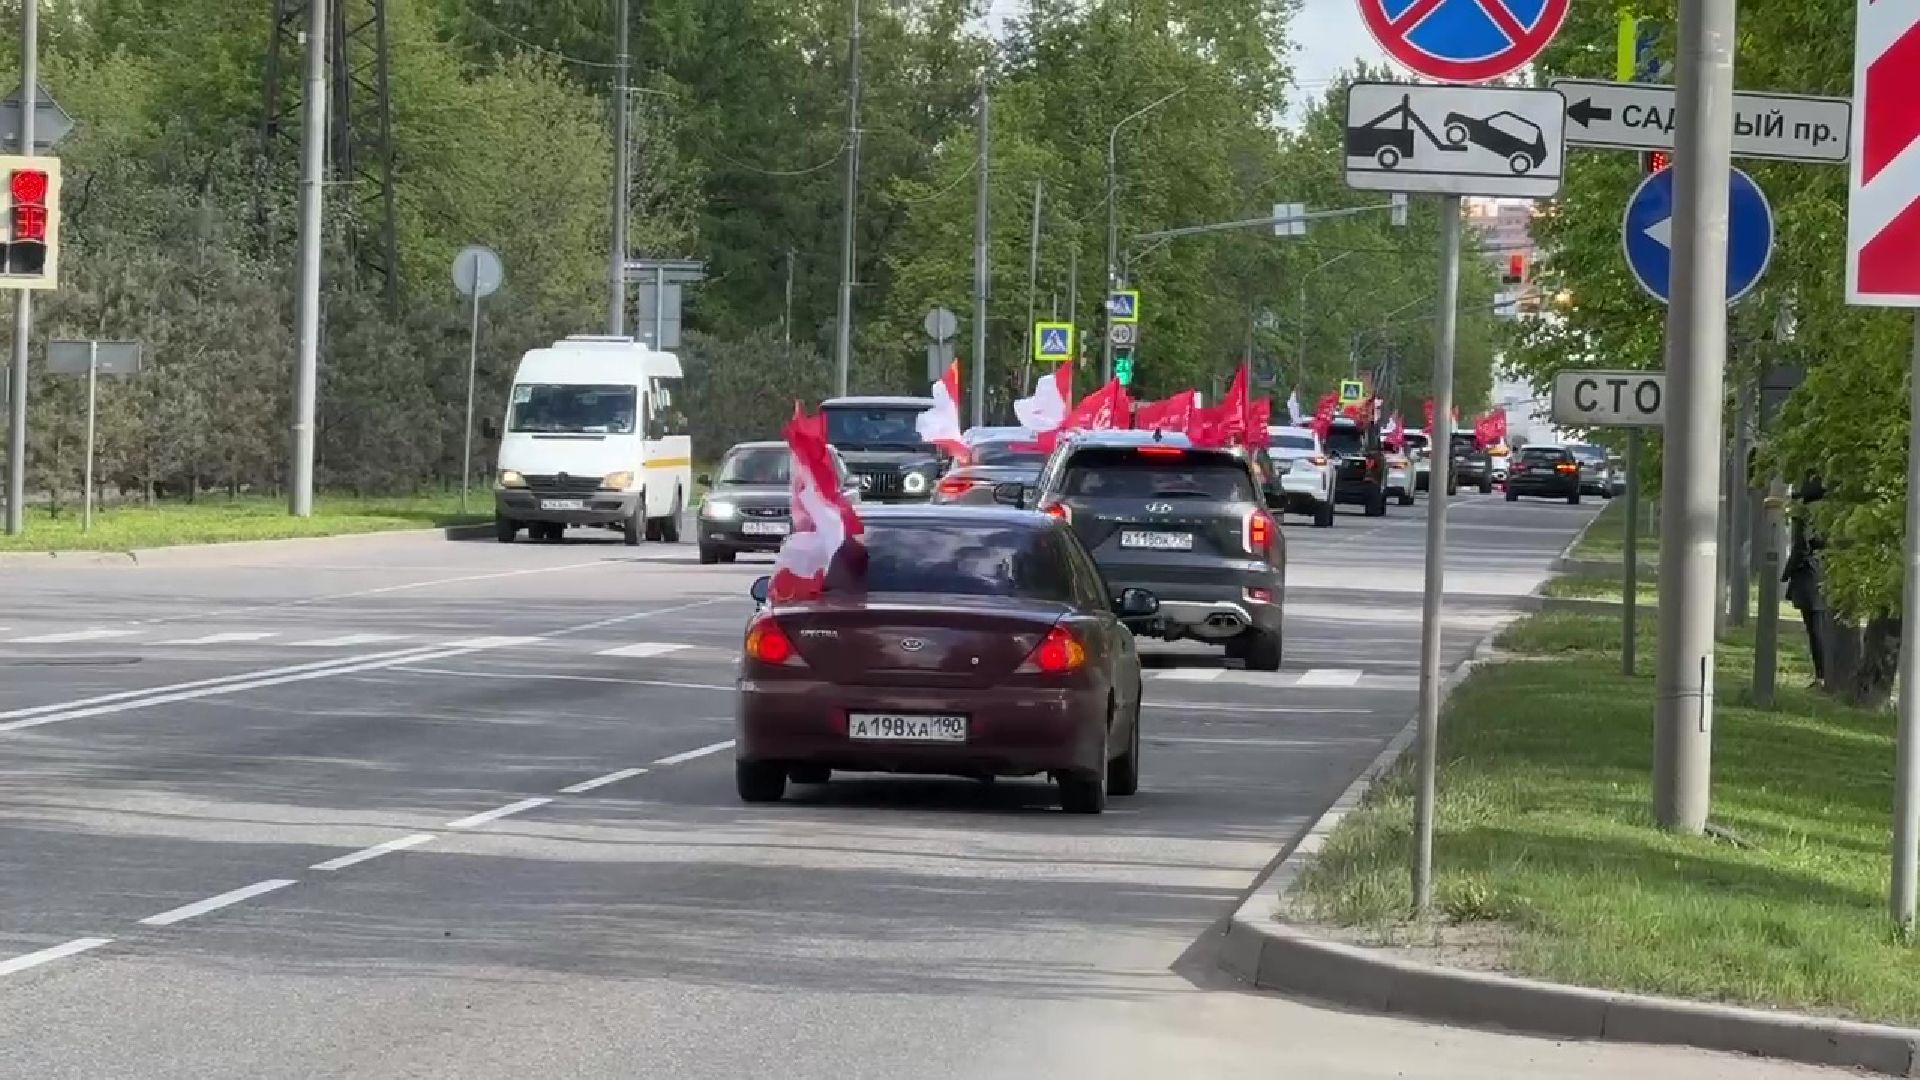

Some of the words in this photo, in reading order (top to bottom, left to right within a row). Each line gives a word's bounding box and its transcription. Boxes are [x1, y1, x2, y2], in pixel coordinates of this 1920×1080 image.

[1622, 104, 1784, 139] САЫЙ
[1794, 122, 1838, 147] пр.
[1113, 327, 1130, 339] 40
[1575, 379, 1661, 414] СТО
[855, 717, 929, 737] А198ХА
[933, 718, 962, 734] 190
